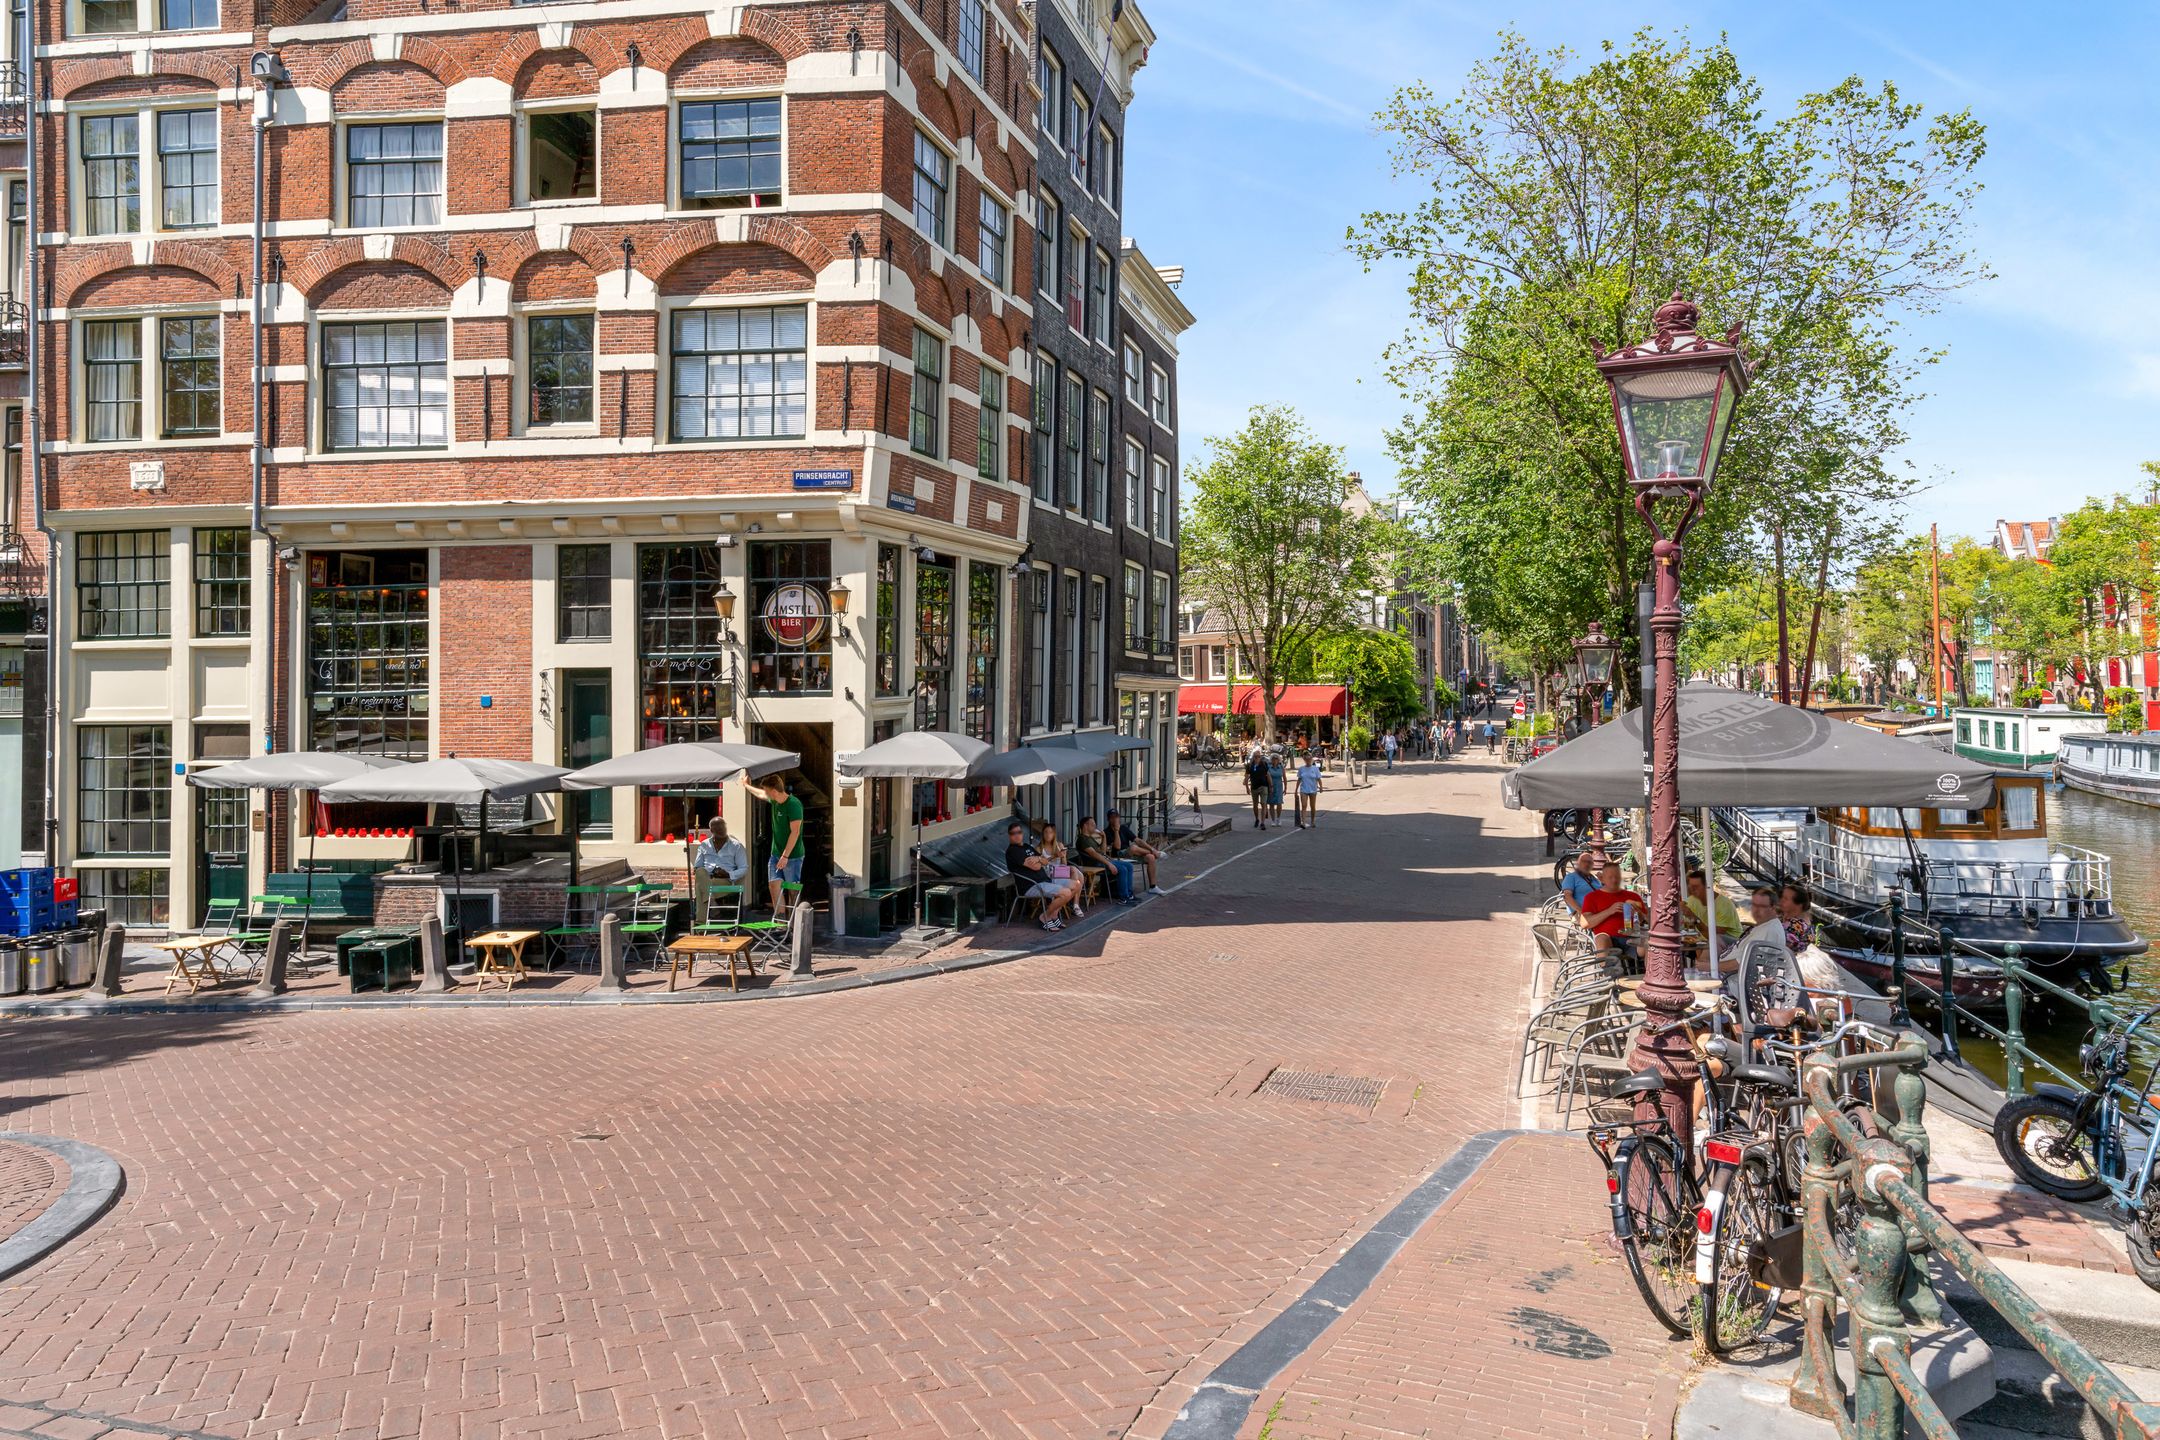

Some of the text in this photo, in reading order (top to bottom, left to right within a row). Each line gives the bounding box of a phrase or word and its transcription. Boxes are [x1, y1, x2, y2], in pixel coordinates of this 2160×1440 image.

[795, 471, 849, 480] PRINSENGRACHT
[781, 618, 801, 626] BIER
[1679, 700, 1769, 735] MSTEL
[1712, 721, 1773, 742] BIER
